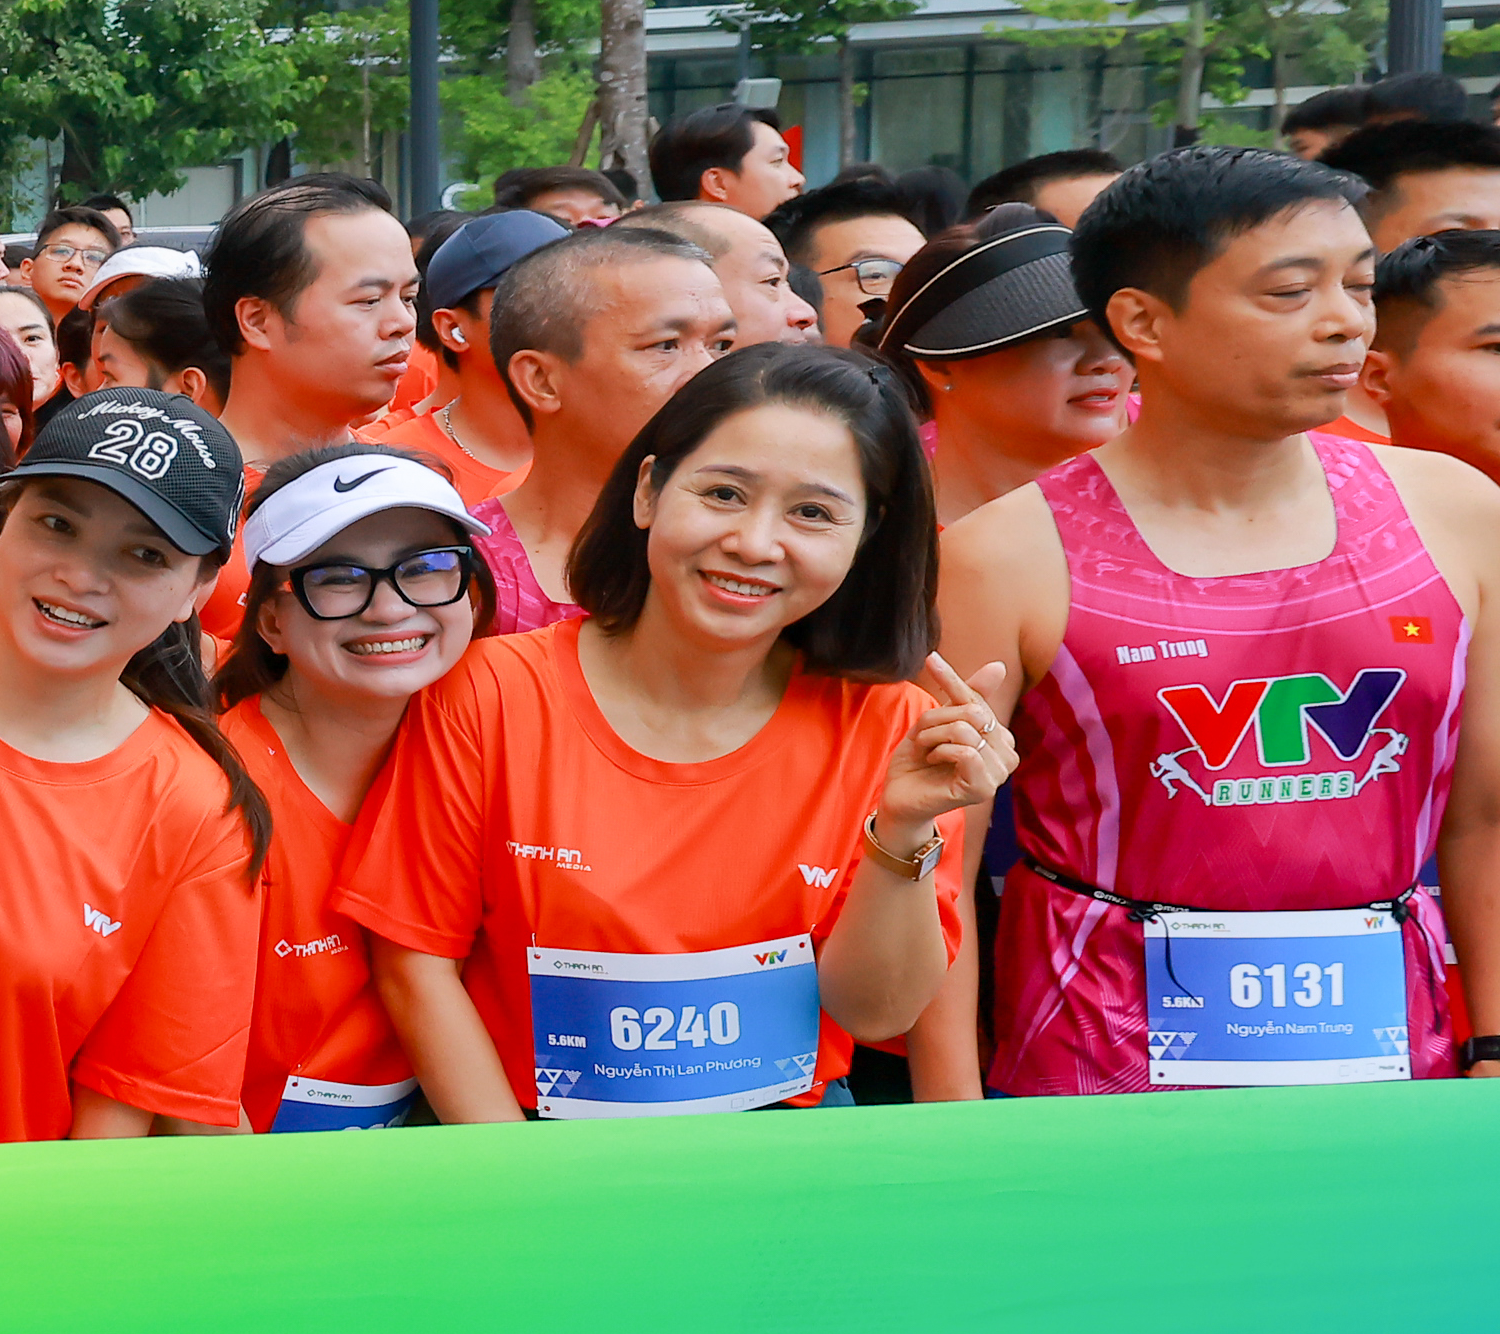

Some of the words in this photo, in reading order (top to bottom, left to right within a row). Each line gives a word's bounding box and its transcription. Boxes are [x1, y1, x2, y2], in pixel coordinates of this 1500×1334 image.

[77, 399, 164, 420] Mickey
[160, 414, 217, 469] Mouse
[87, 418, 180, 480] 28
[1116, 644, 1157, 665] Nam
[1158, 638, 1209, 658] Trung
[1157, 668, 1408, 771] VTV
[1213, 772, 1354, 805] RUNNERS
[556, 862, 592, 872] MEDIA
[557, 848, 582, 865] AN
[797, 863, 839, 889] VTV
[83, 902, 123, 938] VTV
[1364, 916, 1385, 929] VTV
[753, 949, 788, 966] VTV
[1229, 961, 1345, 1009] 6131
[609, 1001, 740, 1052] 6240
[1226, 1021, 1284, 1037] Nguyễn
[1284, 1023, 1317, 1033] Nam
[1318, 1022, 1353, 1036] Trung
[548, 1033, 587, 1049] 5.6KM
[594, 1062, 651, 1080] Nguyễn
[653, 1064, 676, 1080] Thị
[677, 1064, 703, 1075] Lan
[704, 1055, 762, 1076] Phương
